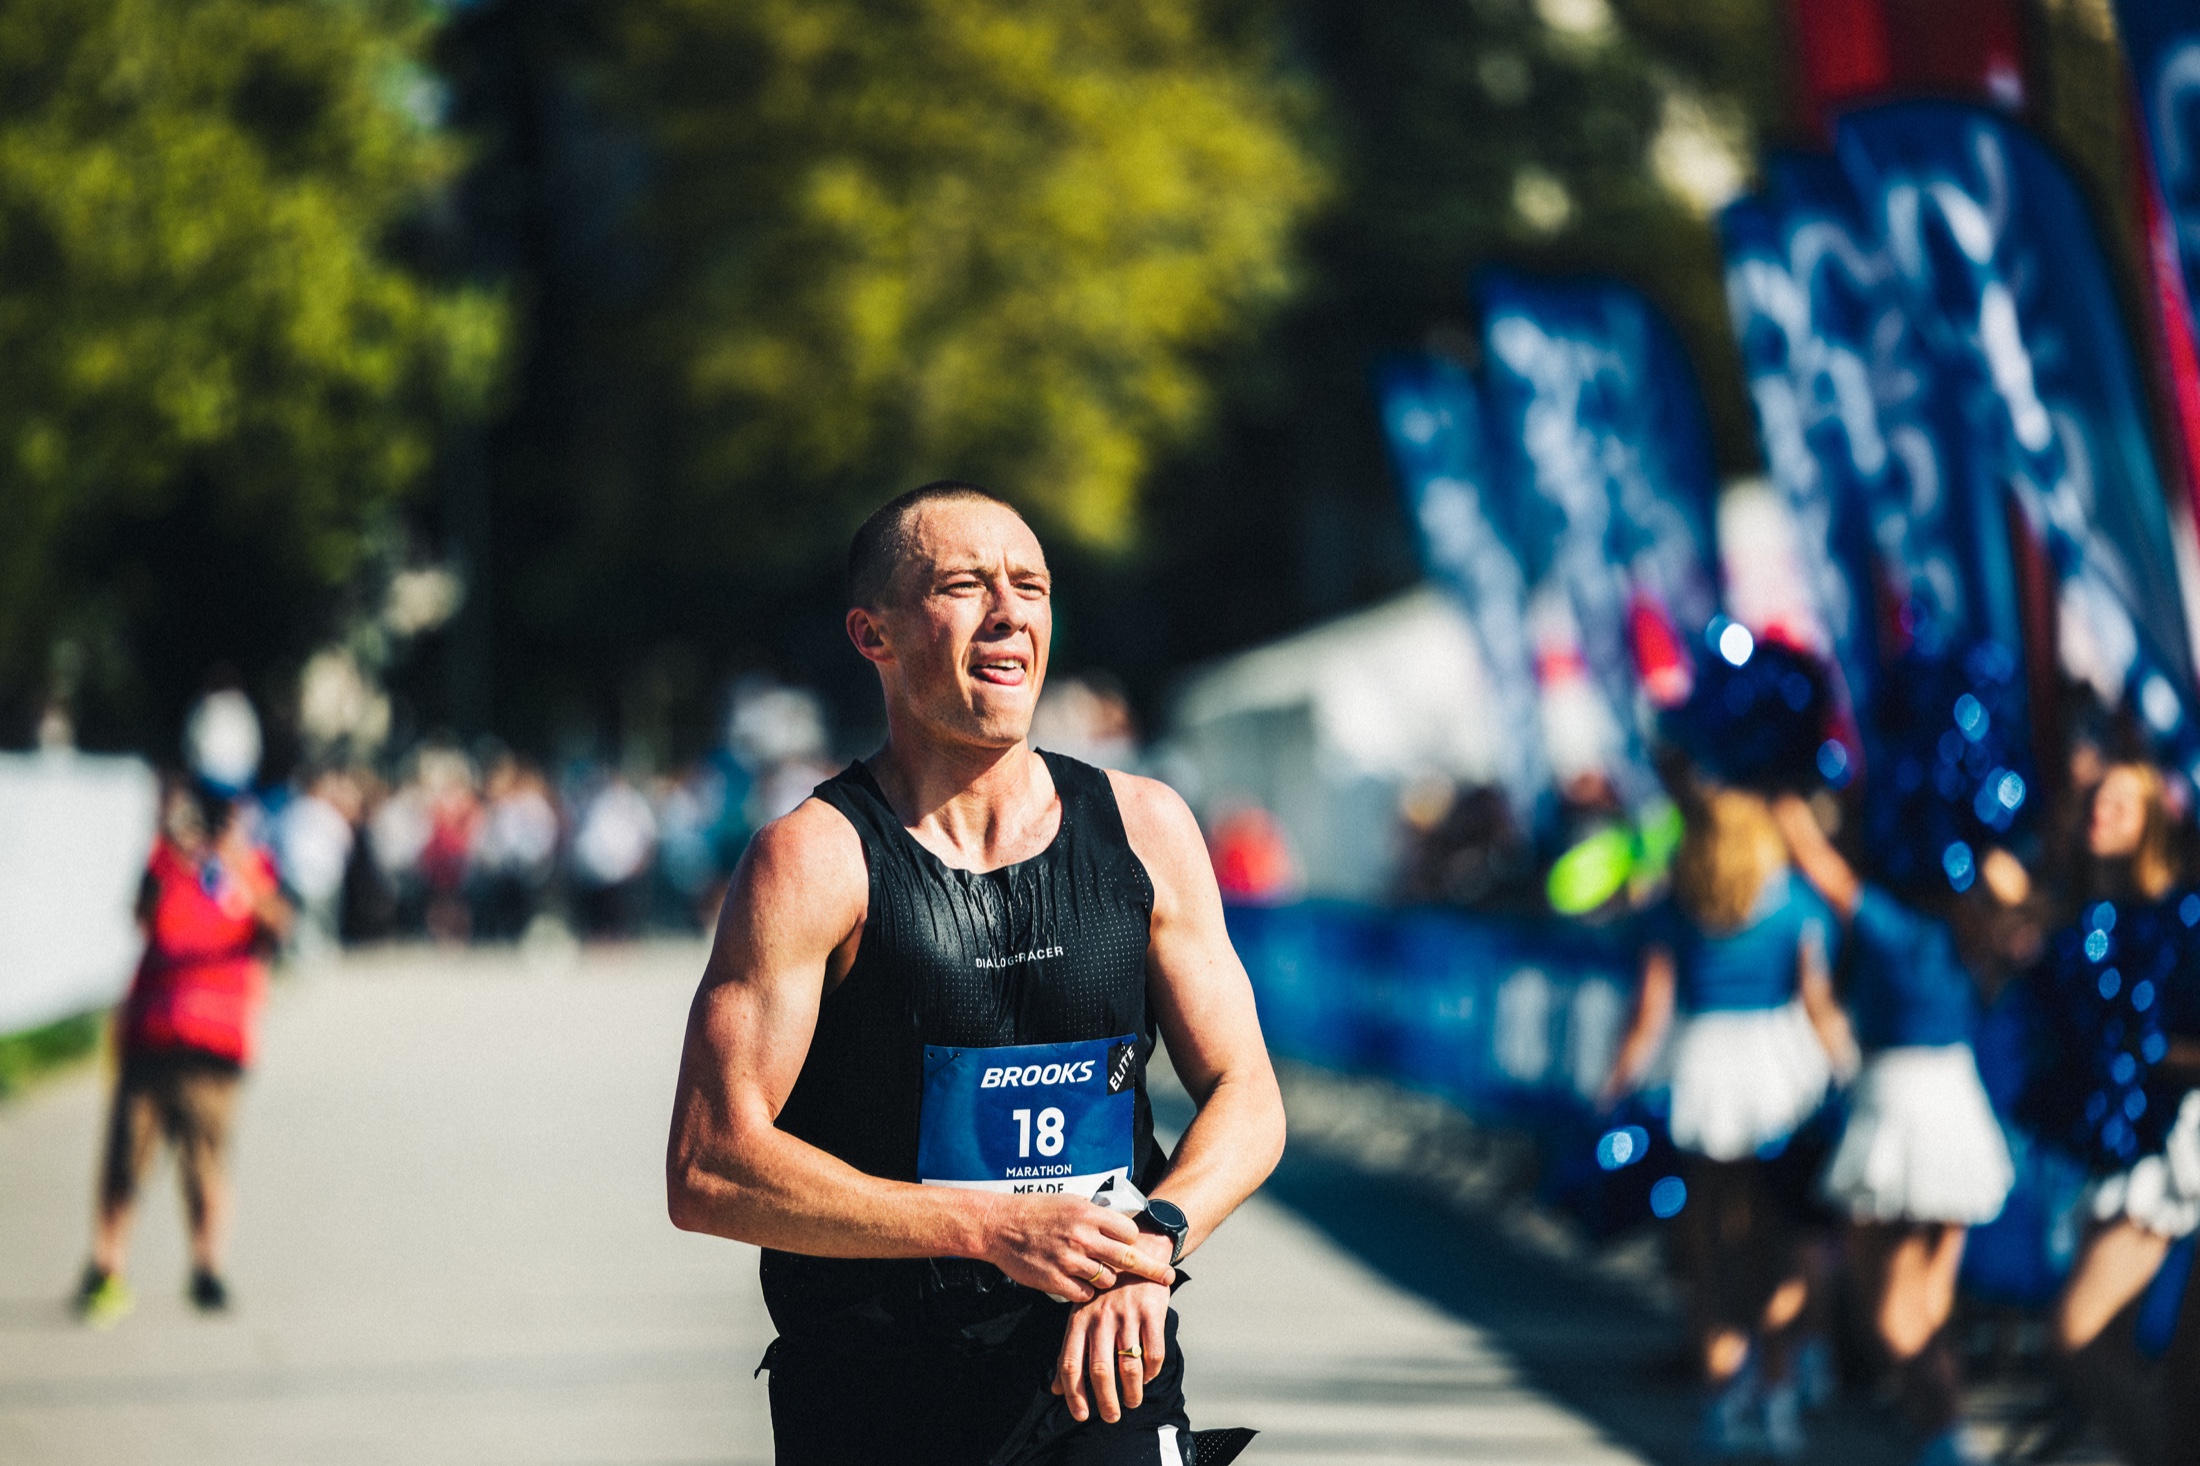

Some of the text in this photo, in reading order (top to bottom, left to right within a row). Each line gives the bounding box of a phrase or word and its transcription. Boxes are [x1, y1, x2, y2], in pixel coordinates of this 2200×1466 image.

[980, 1060, 1095, 1088] BROOKS
[1109, 1045, 1135, 1091] ELITE
[1013, 1106, 1065, 1158] 18
[1006, 1163, 1072, 1177] MARATHON
